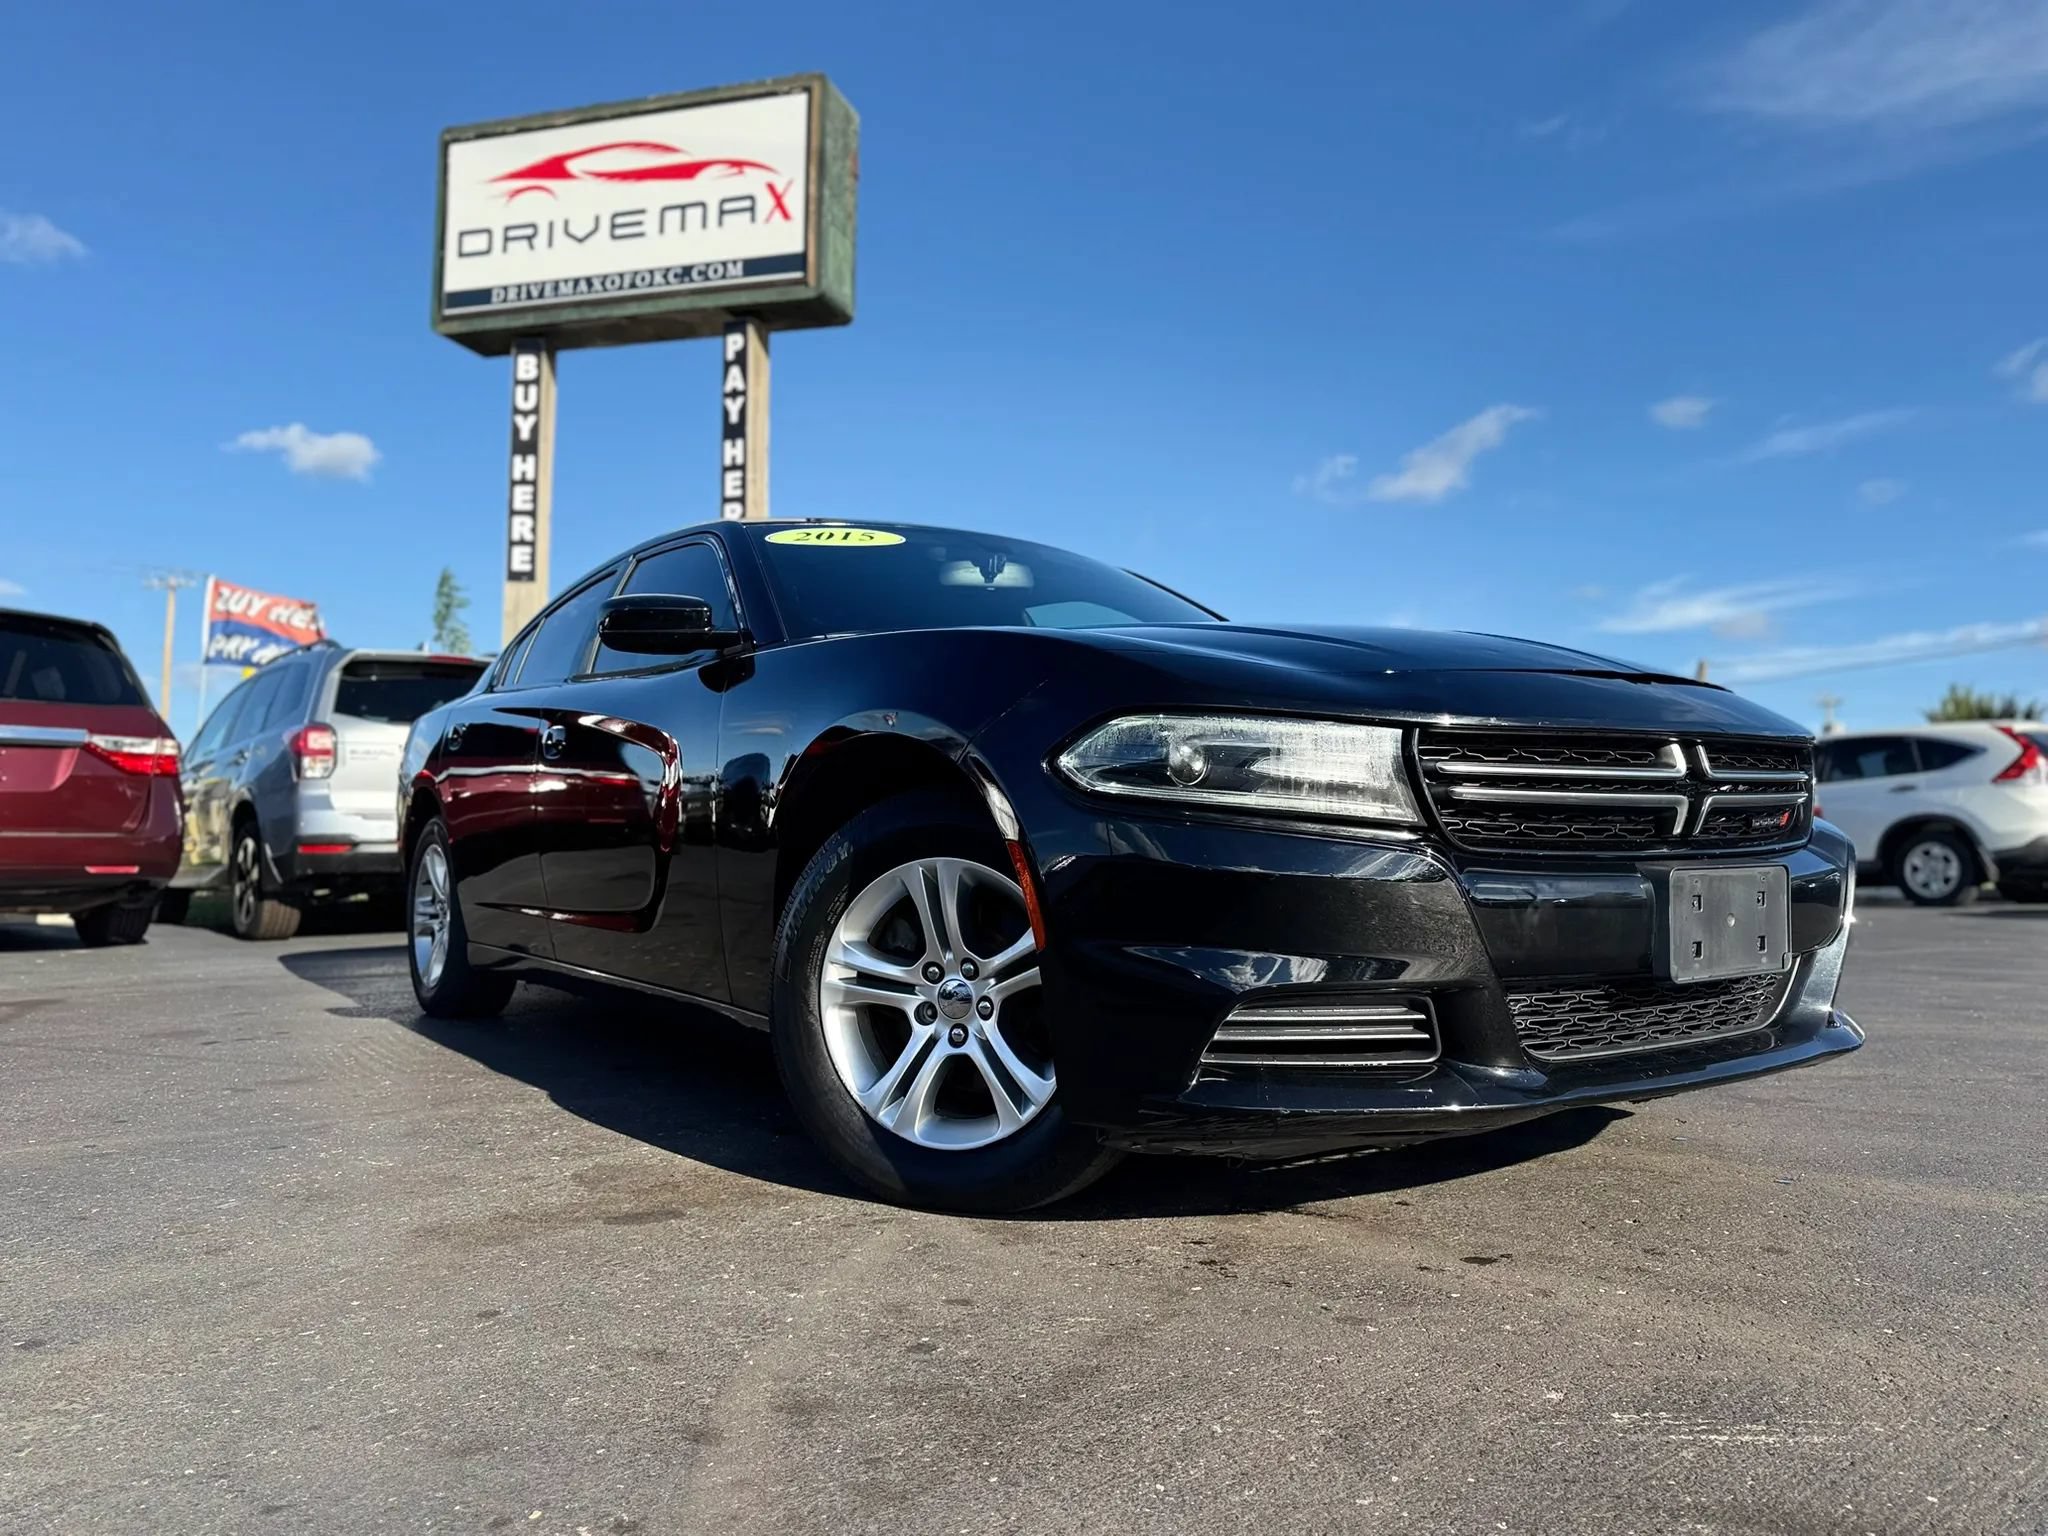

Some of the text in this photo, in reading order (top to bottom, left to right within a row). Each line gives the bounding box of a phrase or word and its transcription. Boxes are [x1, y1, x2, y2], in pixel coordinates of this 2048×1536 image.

[458, 179, 794, 259] DRIVEMAX
[490, 260, 745, 304] DRIVEMAXOFOKC.COM
[510, 353, 539, 573] BUY HERE
[722, 332, 746, 520] PAY HER
[793, 531, 876, 542] 2015
